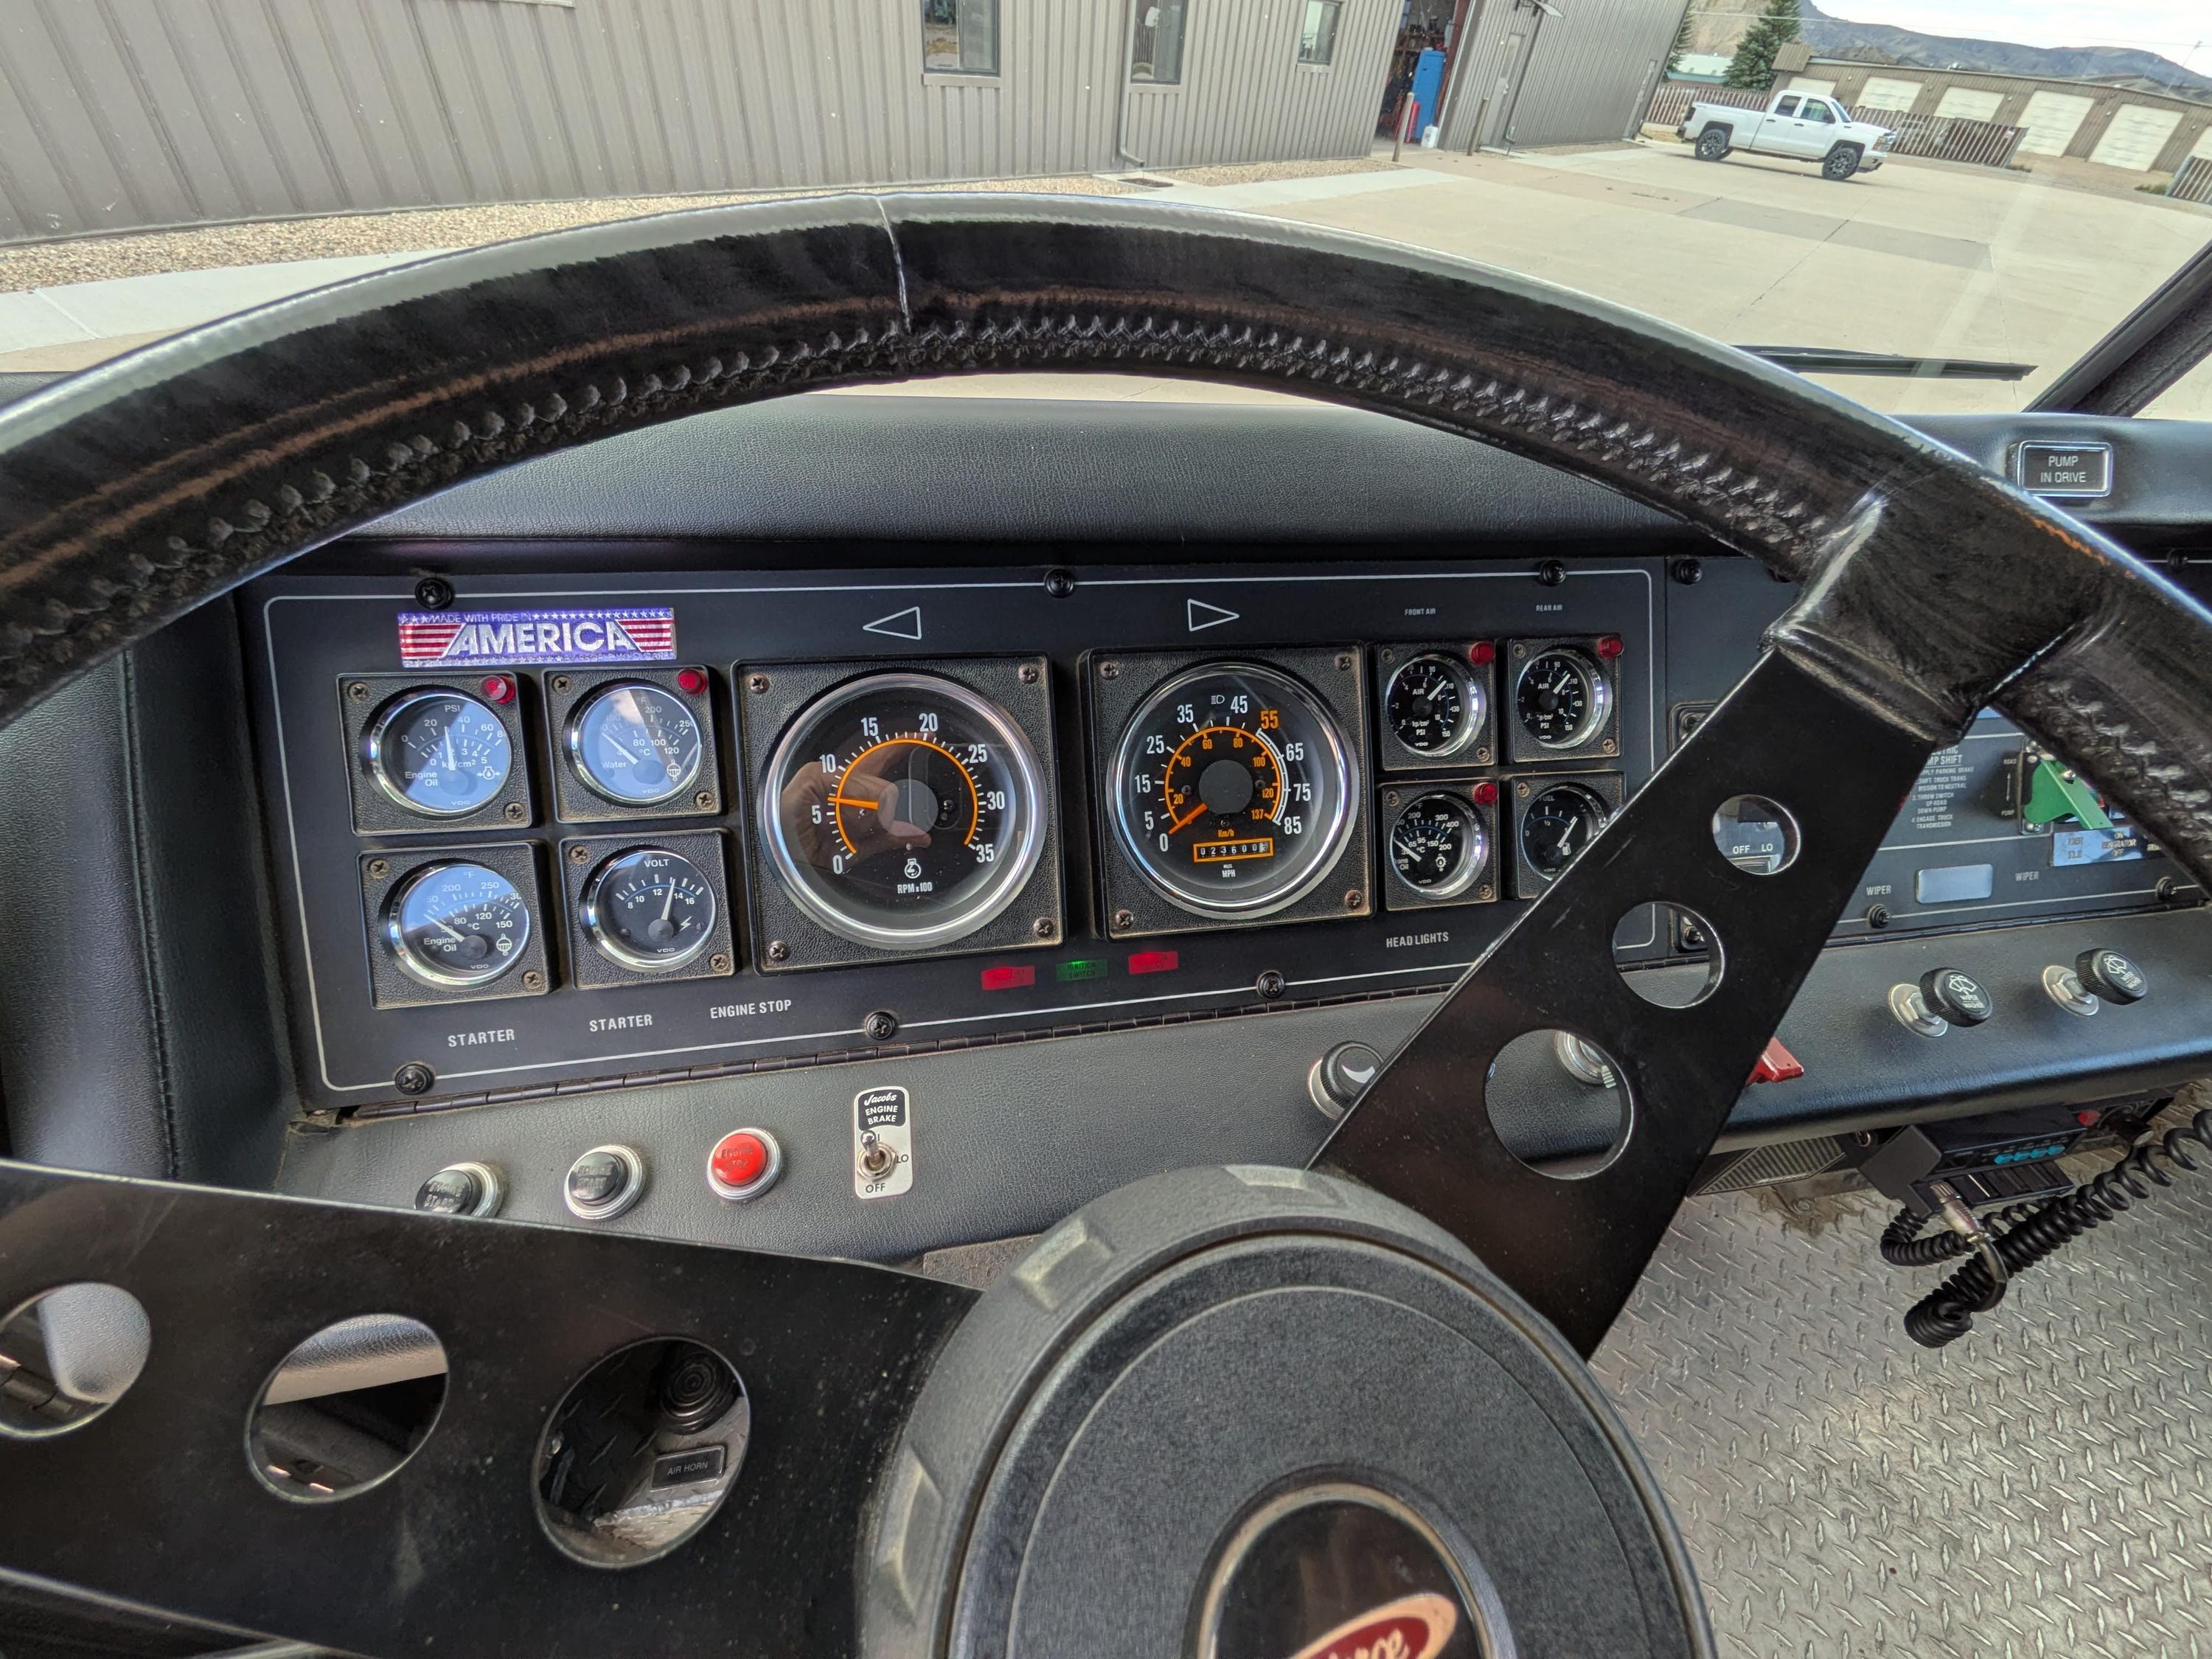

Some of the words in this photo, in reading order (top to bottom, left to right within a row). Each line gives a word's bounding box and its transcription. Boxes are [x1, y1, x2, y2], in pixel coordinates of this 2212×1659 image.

[2048, 456, 2079, 467] PUMP
[2040, 472, 2051, 483] IN
[2054, 472, 2087, 483] DRIVE
[428, 613, 461, 623] MADE
[464, 613, 488, 622] WITH
[491, 613, 518, 622] PRIDE
[521, 613, 532, 621] IN
[447, 619, 634, 655] AMERICA
[1231, 695, 1248, 714] 45
[1177, 704, 1194, 723] 35
[424, 719, 437, 727] 20
[919, 713, 939, 732] 20
[1261, 710, 1279, 729] 55
[861, 717, 879, 737] 15
[1146, 735, 1164, 754] 25
[1203, 739, 1212, 750] 60
[1233, 737, 1243, 748] 80
[968, 744, 987, 763] 25
[1286, 742, 1304, 762] 65
[602, 761, 627, 769] Water
[820, 754, 836, 773] 10
[1180, 757, 1191, 768] 40
[1253, 757, 1265, 768] 100
[1940, 754, 1963, 765] SHIFT
[406, 771, 437, 782] Engine
[425, 779, 438, 787] Oil
[1135, 774, 1150, 793] 15
[1262, 787, 1274, 799] 120
[1293, 783, 1311, 801] 75
[987, 791, 1005, 810] 30
[1173, 794, 1183, 804] 20
[812, 805, 822, 824] 5
[1251, 809, 1264, 820] 137
[1144, 811, 1154, 830] 5
[1284, 816, 1302, 835] 85
[1217, 829, 1235, 838] Km/h
[1159, 833, 1168, 852] 0
[1761, 844, 1773, 852] LO
[976, 844, 995, 863] 35
[1733, 845, 1750, 855] OFF
[644, 859, 669, 868] VOLT
[832, 855, 843, 874] 0
[1222, 869, 1236, 878] MPH
[2015, 871, 2039, 882] WIPER
[1866, 886, 1891, 896] WIPER
[424, 938, 456, 947] Engine
[709, 1003, 757, 1020] ENGINE
[759, 999, 792, 1015] STOP
[589, 1014, 653, 1032] STARTER
[447, 1029, 515, 1048] STARTER
[864, 1092, 897, 1106] Jacobs
[865, 1105, 898, 1116] ENGINE
[867, 1115, 897, 1125] BRAKE
[896, 1154, 909, 1164] LO
[866, 1183, 886, 1194] OFF
[667, 1464, 681, 1475] AIR
[684, 1461, 709, 1473] HORN
